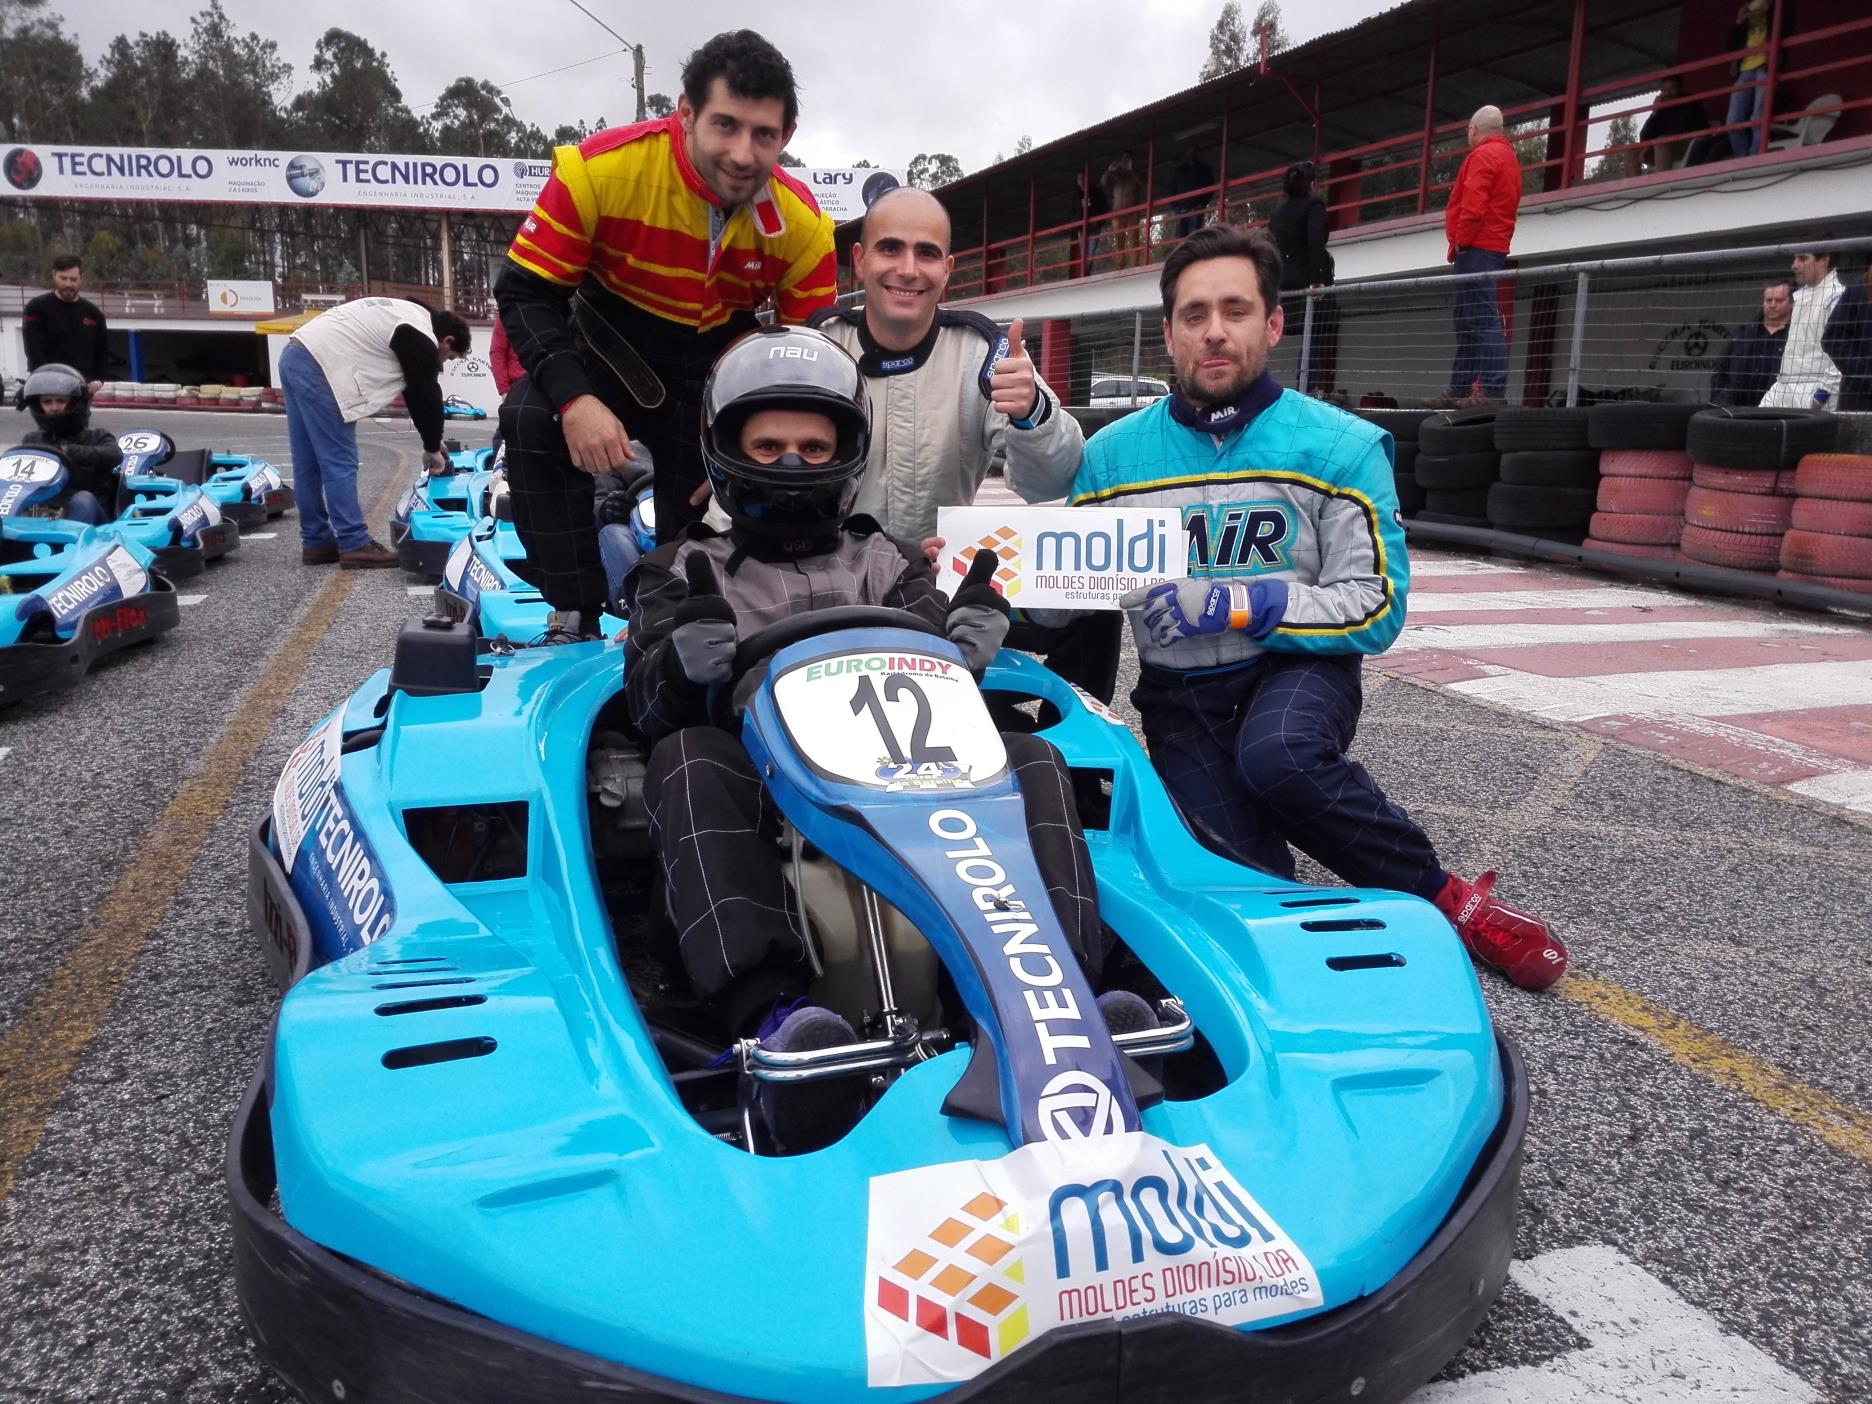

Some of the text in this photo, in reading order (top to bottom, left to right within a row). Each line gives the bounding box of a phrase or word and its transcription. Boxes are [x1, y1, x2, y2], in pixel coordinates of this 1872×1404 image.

[51, 152, 214, 179] TECNIROLO
[226, 153, 280, 168] worknc
[335, 159, 500, 188] TECNIROLO
[812, 172, 854, 185] Lary
[74, 183, 123, 191] ENGENHARIA
[358, 191, 407, 199] ENGENHARIA
[815, 191, 837, 199] NJEÇÃO
[769, 345, 819, 363] nau
[881, 357, 914, 369] sparco
[123, 436, 150, 451] 26
[11, 459, 36, 479] 14
[1035, 518, 1167, 574] moldi
[48, 566, 111, 619] TECNIROLO
[1035, 575, 1085, 590] MOLDES
[1065, 591, 1111, 600] estruturas
[806, 656, 952, 682] EUROINDY
[849, 674, 959, 765] 12
[887, 762, 944, 779] 24
[1457, 893, 1483, 926] sparco
[927, 808, 1092, 1066] TECNIROLO
[1047, 1149, 1276, 1281] moldi
[1057, 1272, 1157, 1323] MOLDES
[1213, 1288, 1249, 1316] para
